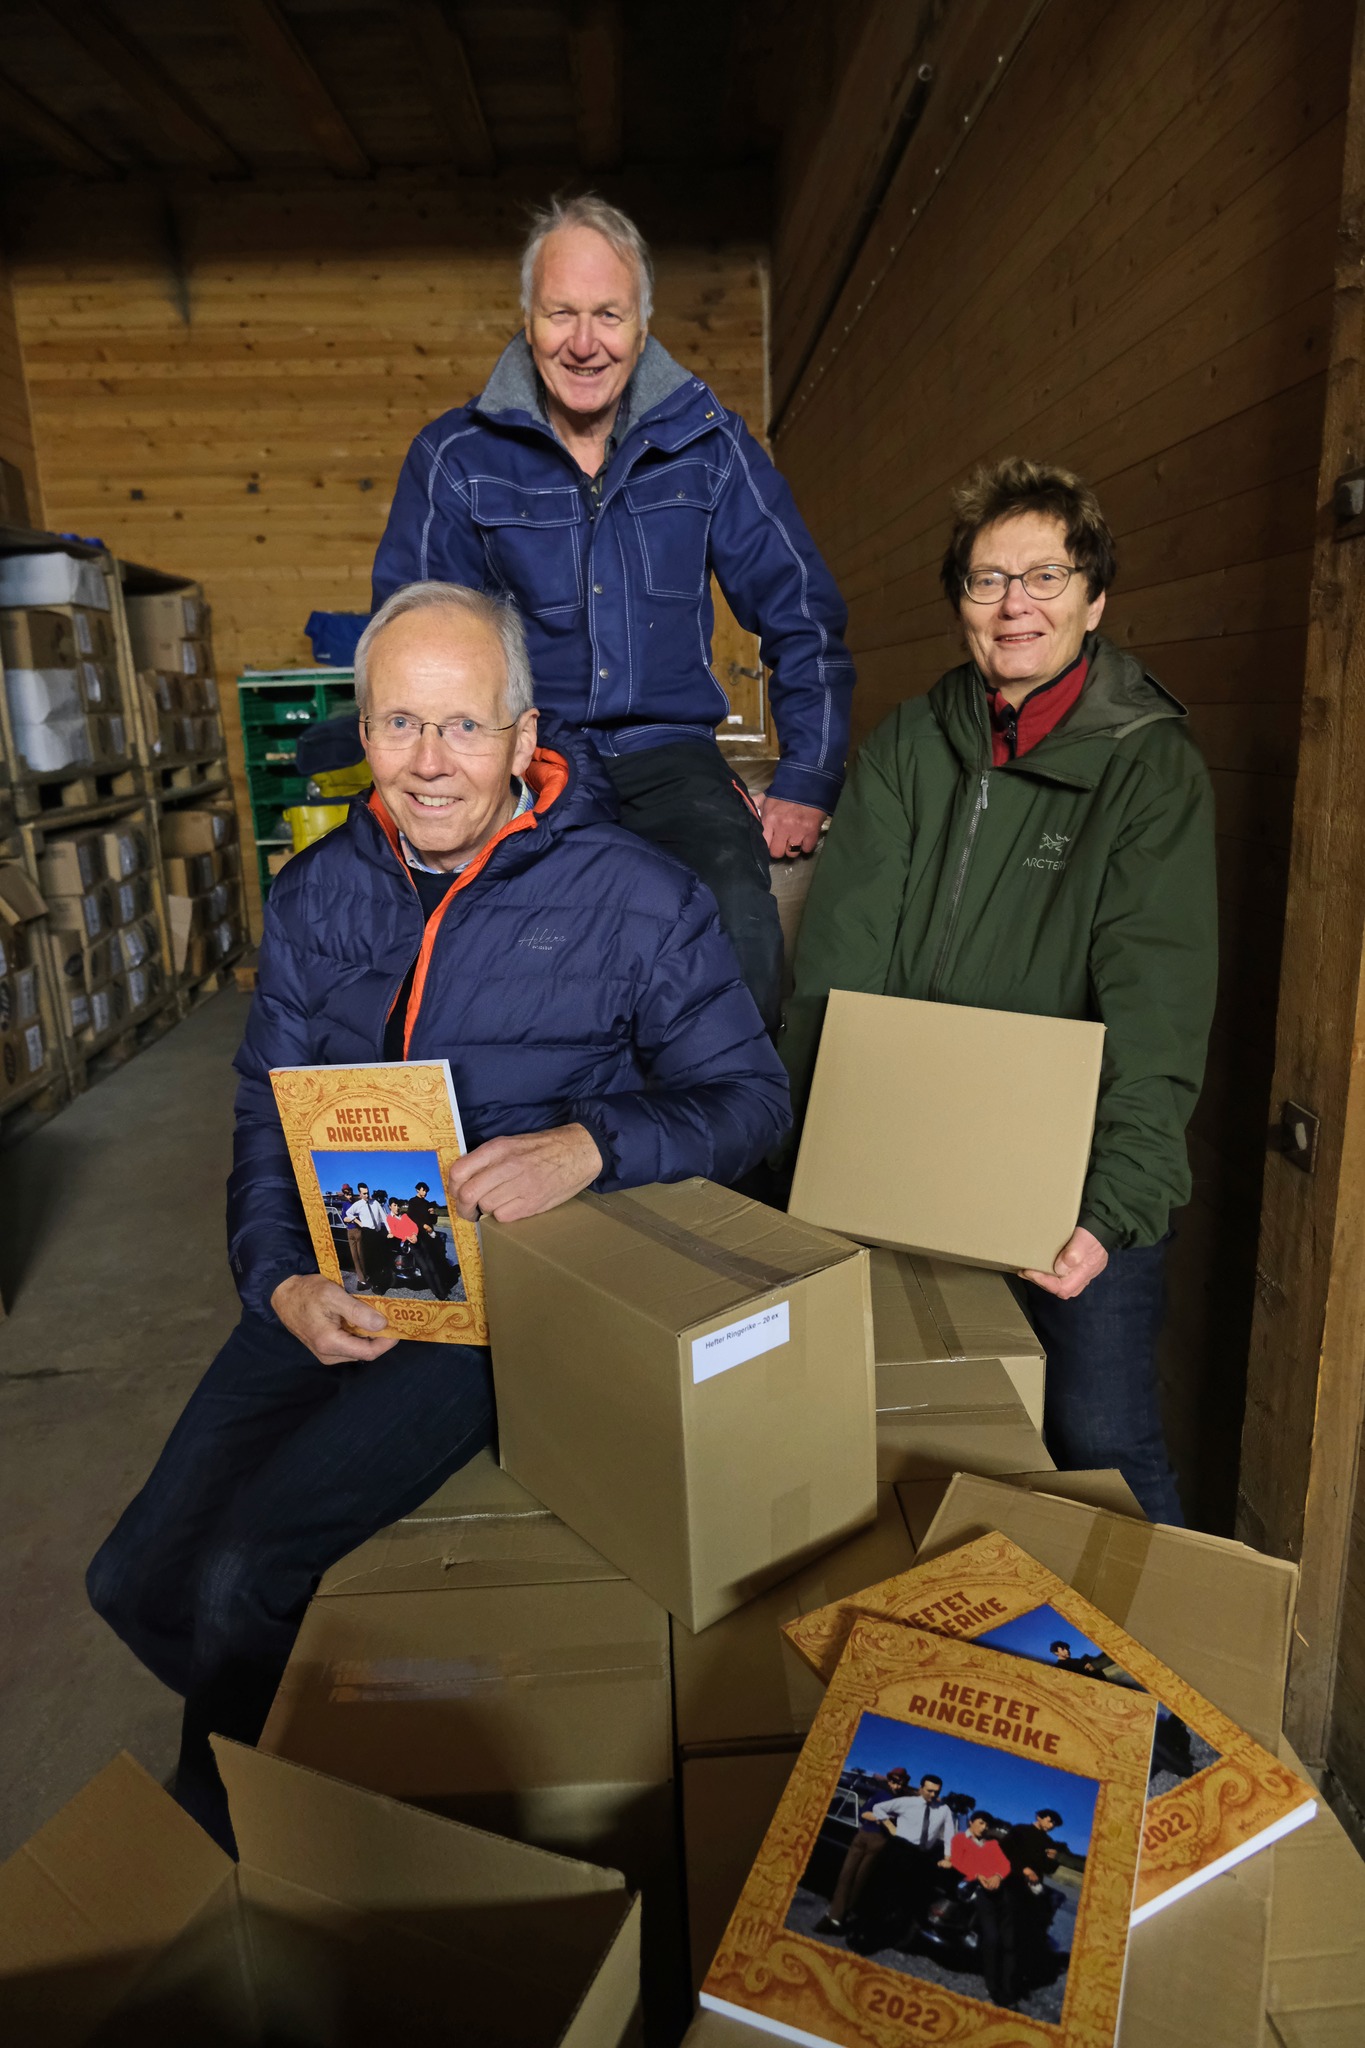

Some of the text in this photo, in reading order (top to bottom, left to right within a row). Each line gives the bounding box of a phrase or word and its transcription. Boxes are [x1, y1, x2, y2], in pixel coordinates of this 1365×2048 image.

[326, 1125, 410, 1143] RINGERIKE
[335, 1107, 390, 1125] HEFTET
[393, 1308, 425, 1322] 2022
[705, 1336, 725, 1350] Hefter
[726, 1322, 756, 1341] Ringerike
[762, 1315, 771, 1325] 20
[939, 1681, 1040, 1724] HEFTET
[908, 1694, 1061, 1755] RINGERIKE
[1142, 1812, 1192, 1851] 2022
[867, 1988, 941, 2034] 2022
